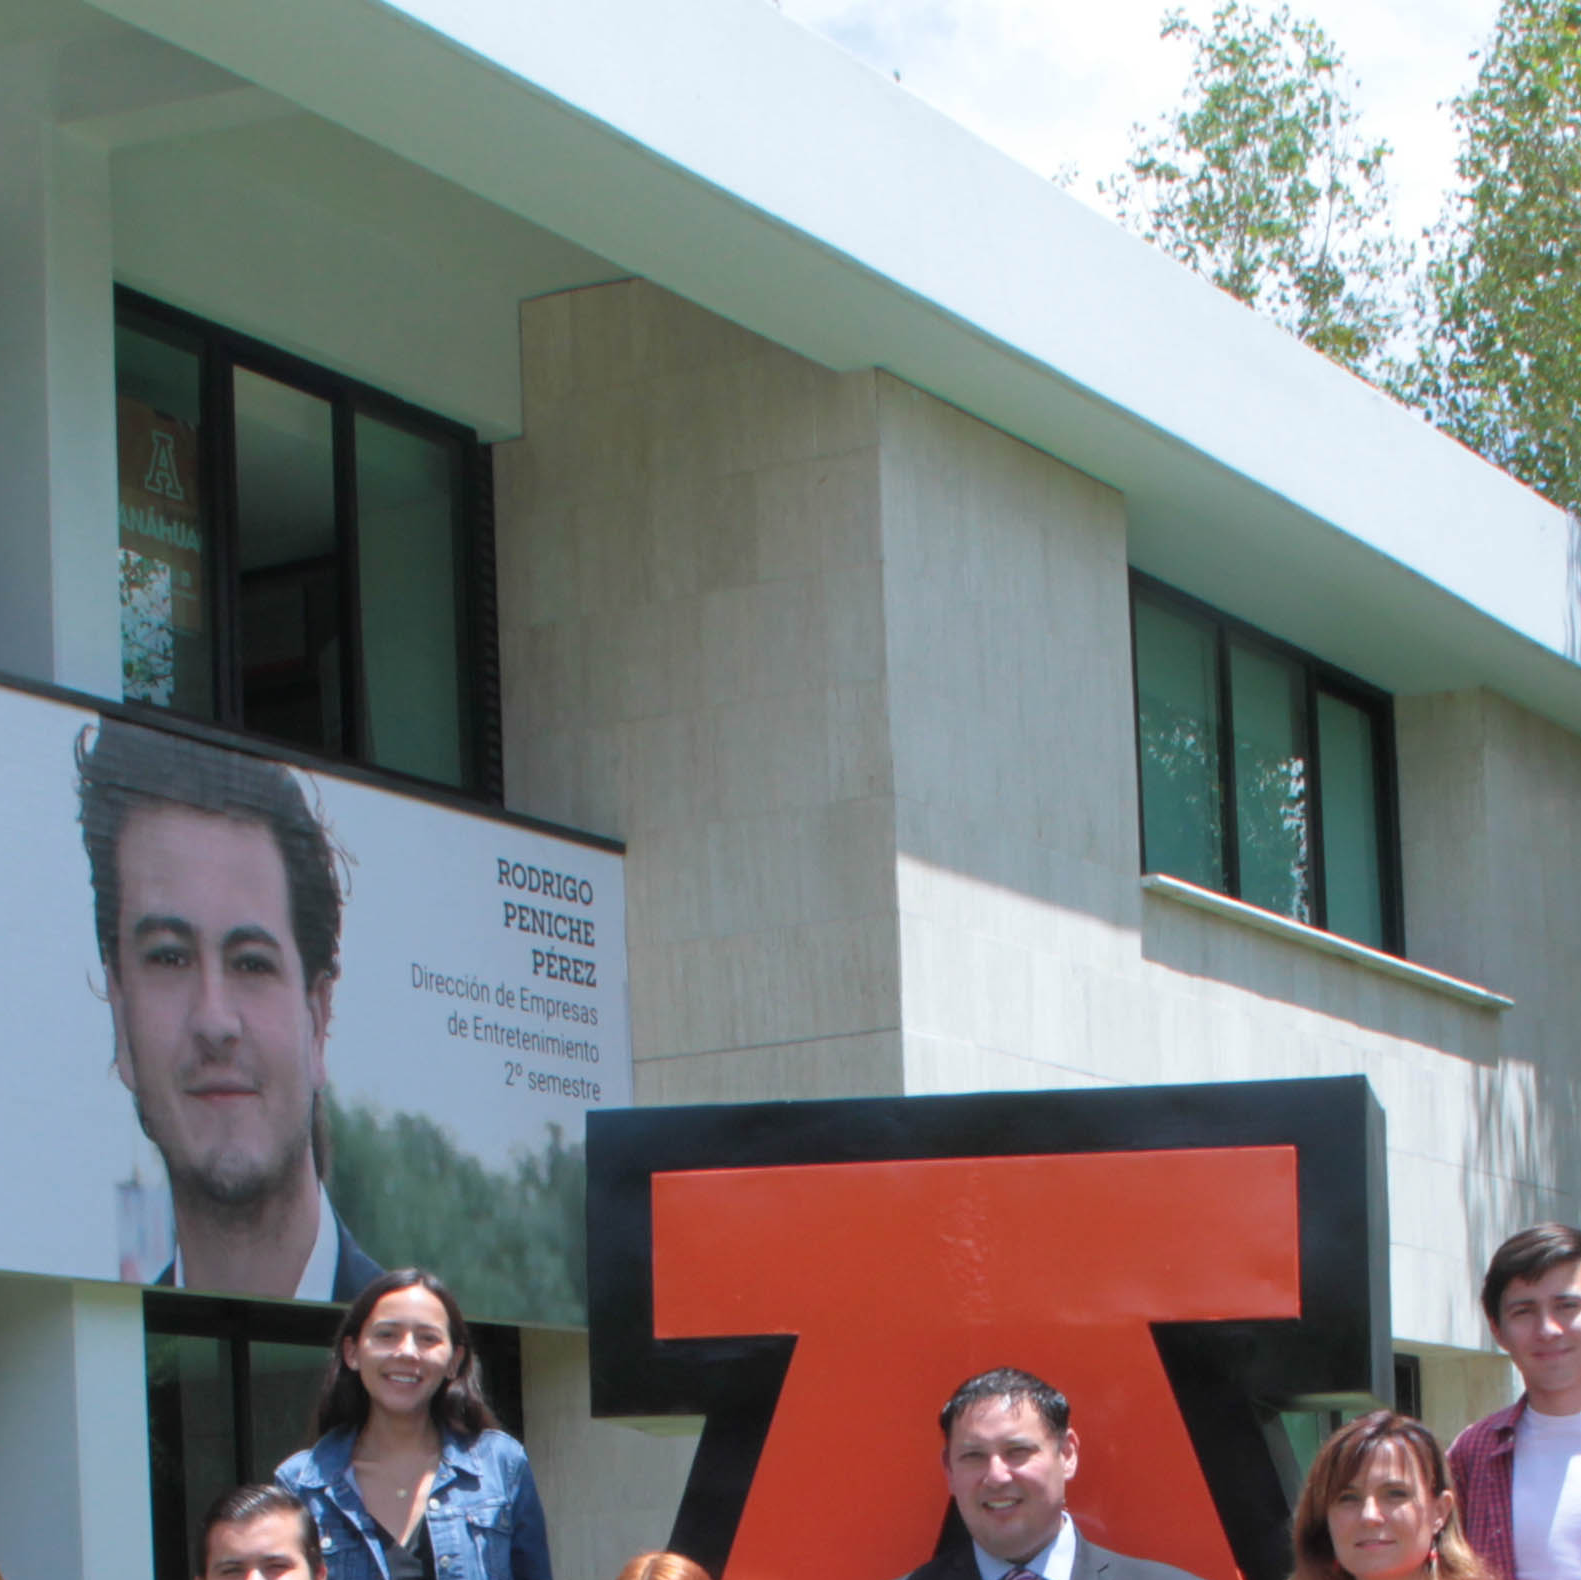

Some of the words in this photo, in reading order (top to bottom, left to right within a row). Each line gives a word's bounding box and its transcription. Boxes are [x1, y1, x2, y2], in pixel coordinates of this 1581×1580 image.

[145, 429, 184, 500] A
[119, 502, 200, 552] ANÁHUA
[497, 857, 594, 906] RODRIGO
[503, 901, 596, 947] PENICHE
[532, 946, 597, 988] PÉREZ
[411, 962, 490, 1003] Dirección
[495, 980, 515, 1009] de
[520, 986, 598, 1027] Empresas
[448, 1010, 468, 1038] de
[473, 1015, 600, 1064] Entretenimiento
[528, 1071, 601, 1101] semestre
